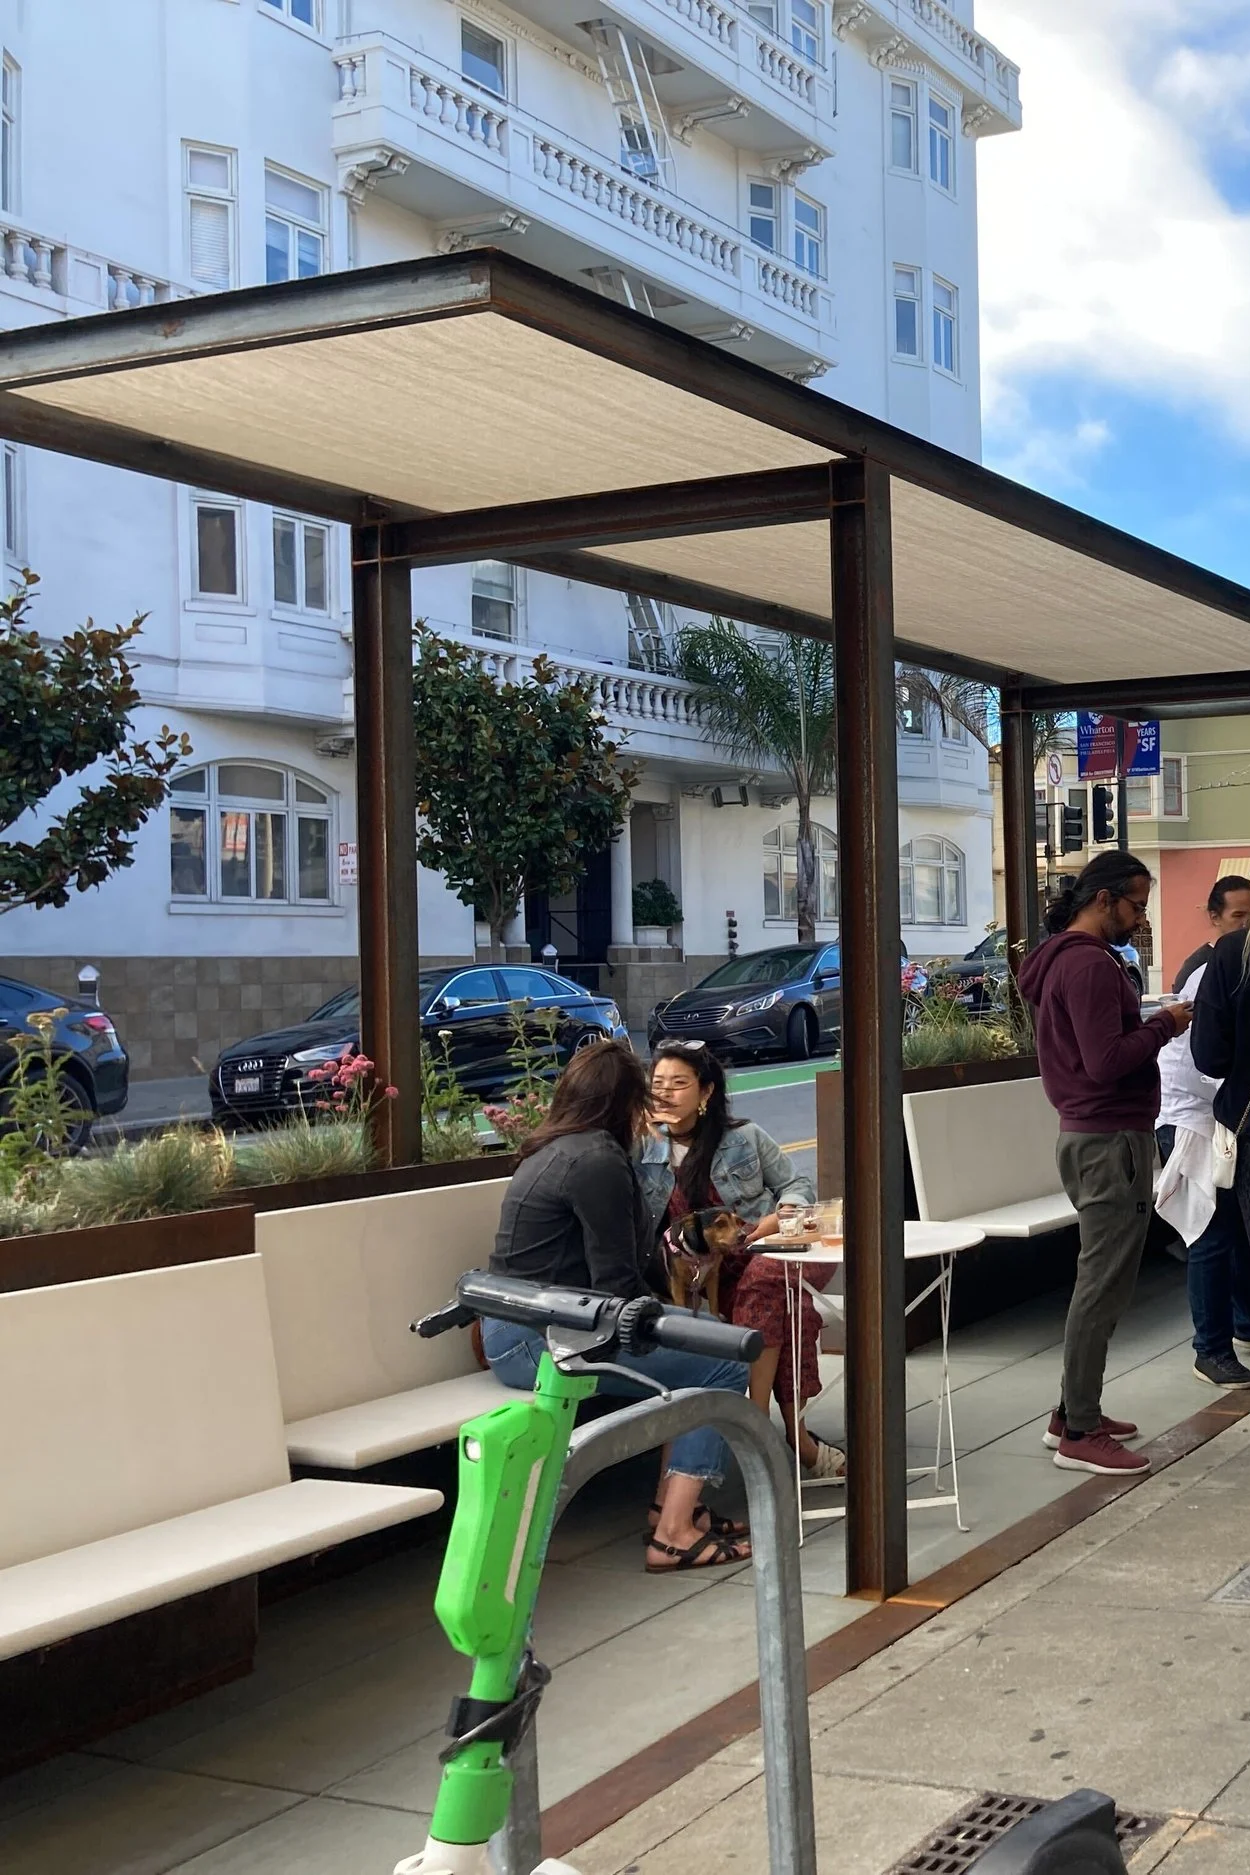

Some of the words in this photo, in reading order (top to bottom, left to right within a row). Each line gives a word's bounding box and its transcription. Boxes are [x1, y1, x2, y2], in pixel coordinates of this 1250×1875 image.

[1080, 725, 1115, 735] Wharton
[1137, 727, 1156, 737] YEARS
[1141, 737, 1156, 752] SF
